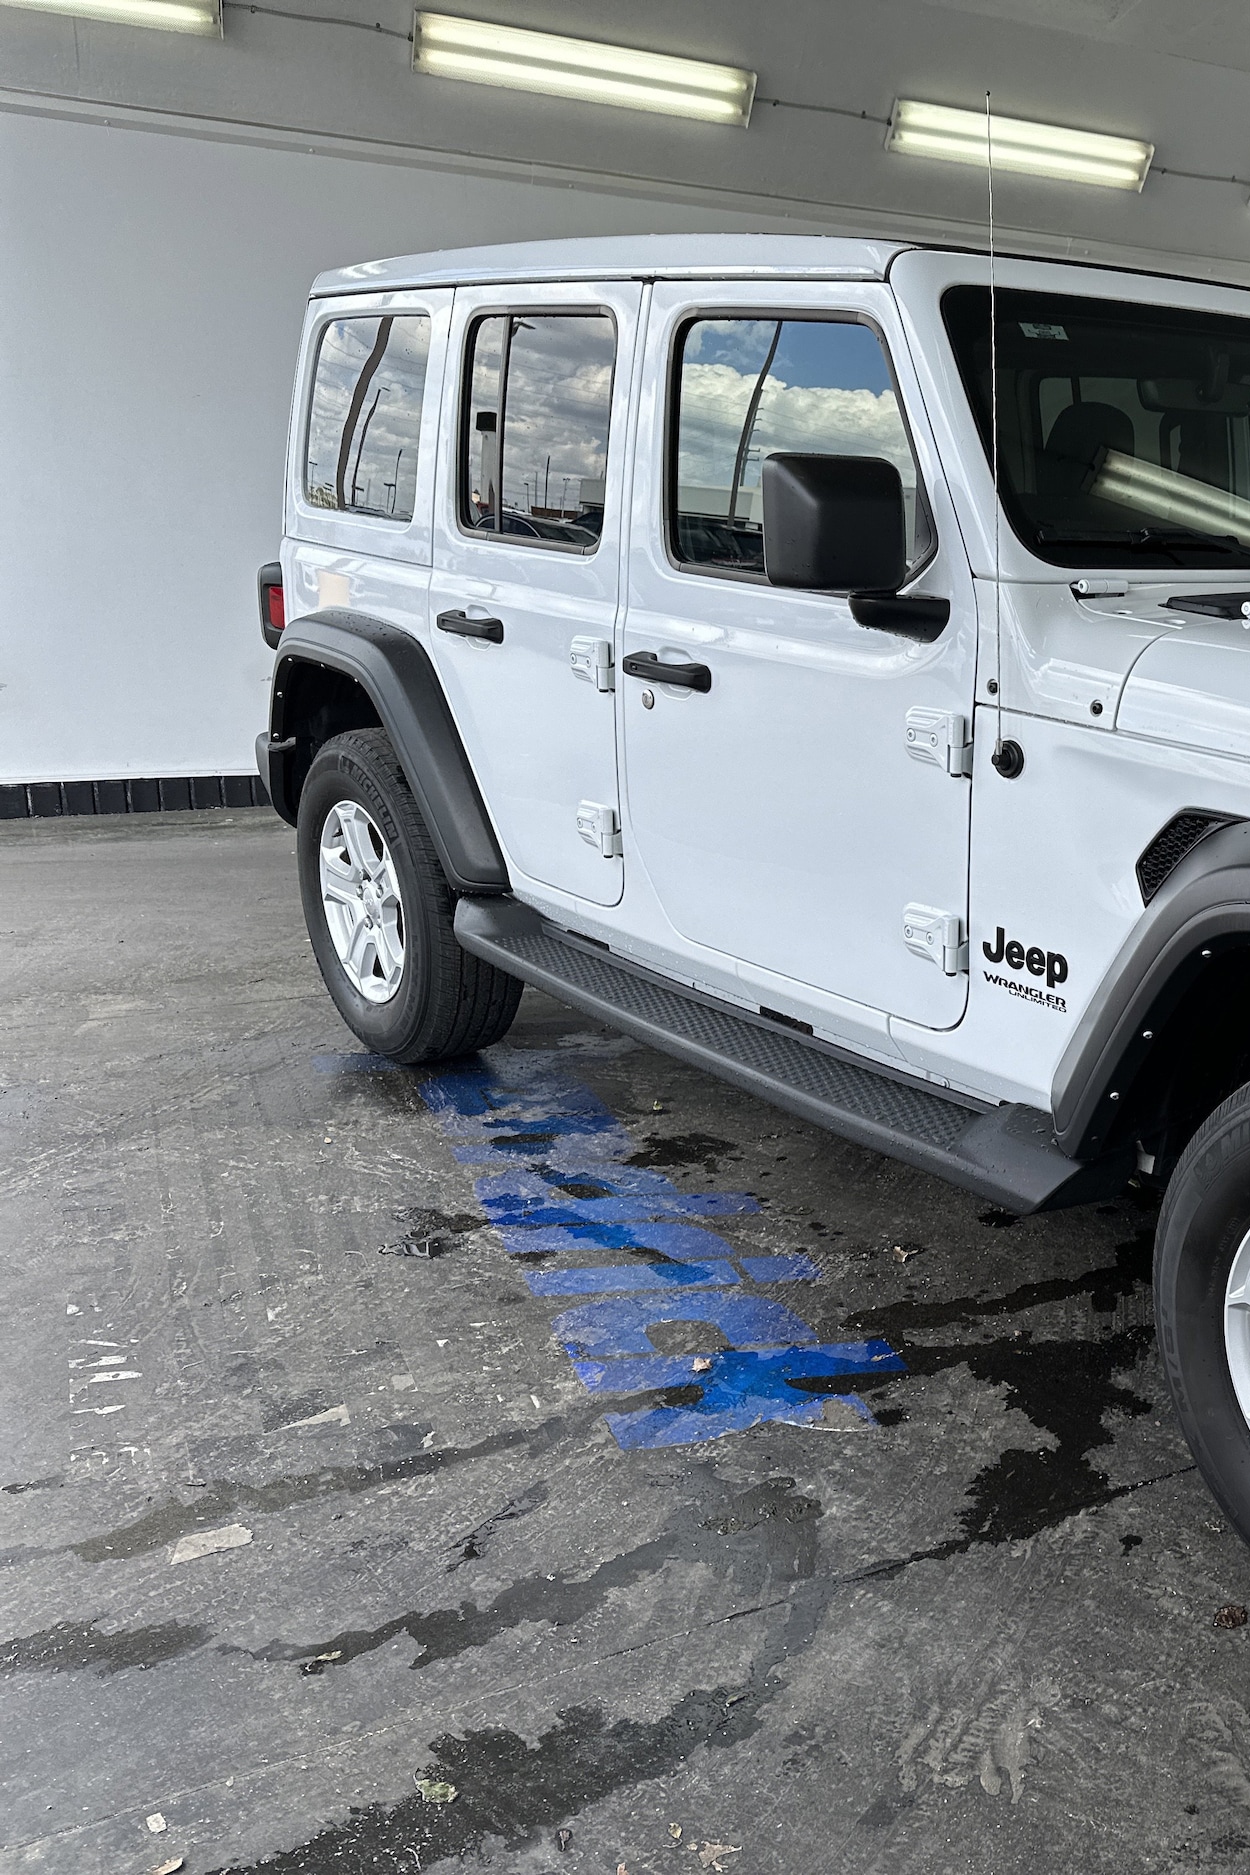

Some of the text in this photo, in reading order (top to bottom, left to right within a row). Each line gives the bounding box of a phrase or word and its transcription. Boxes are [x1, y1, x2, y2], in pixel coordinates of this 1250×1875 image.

[350, 764, 398, 840] MICHELIN
[983, 926, 1069, 988] Jeep
[983, 970, 1067, 1008] WRANGLER
[1008, 989, 1067, 1013] UNLIMITED
[311, 1051, 909, 1450] endrick
